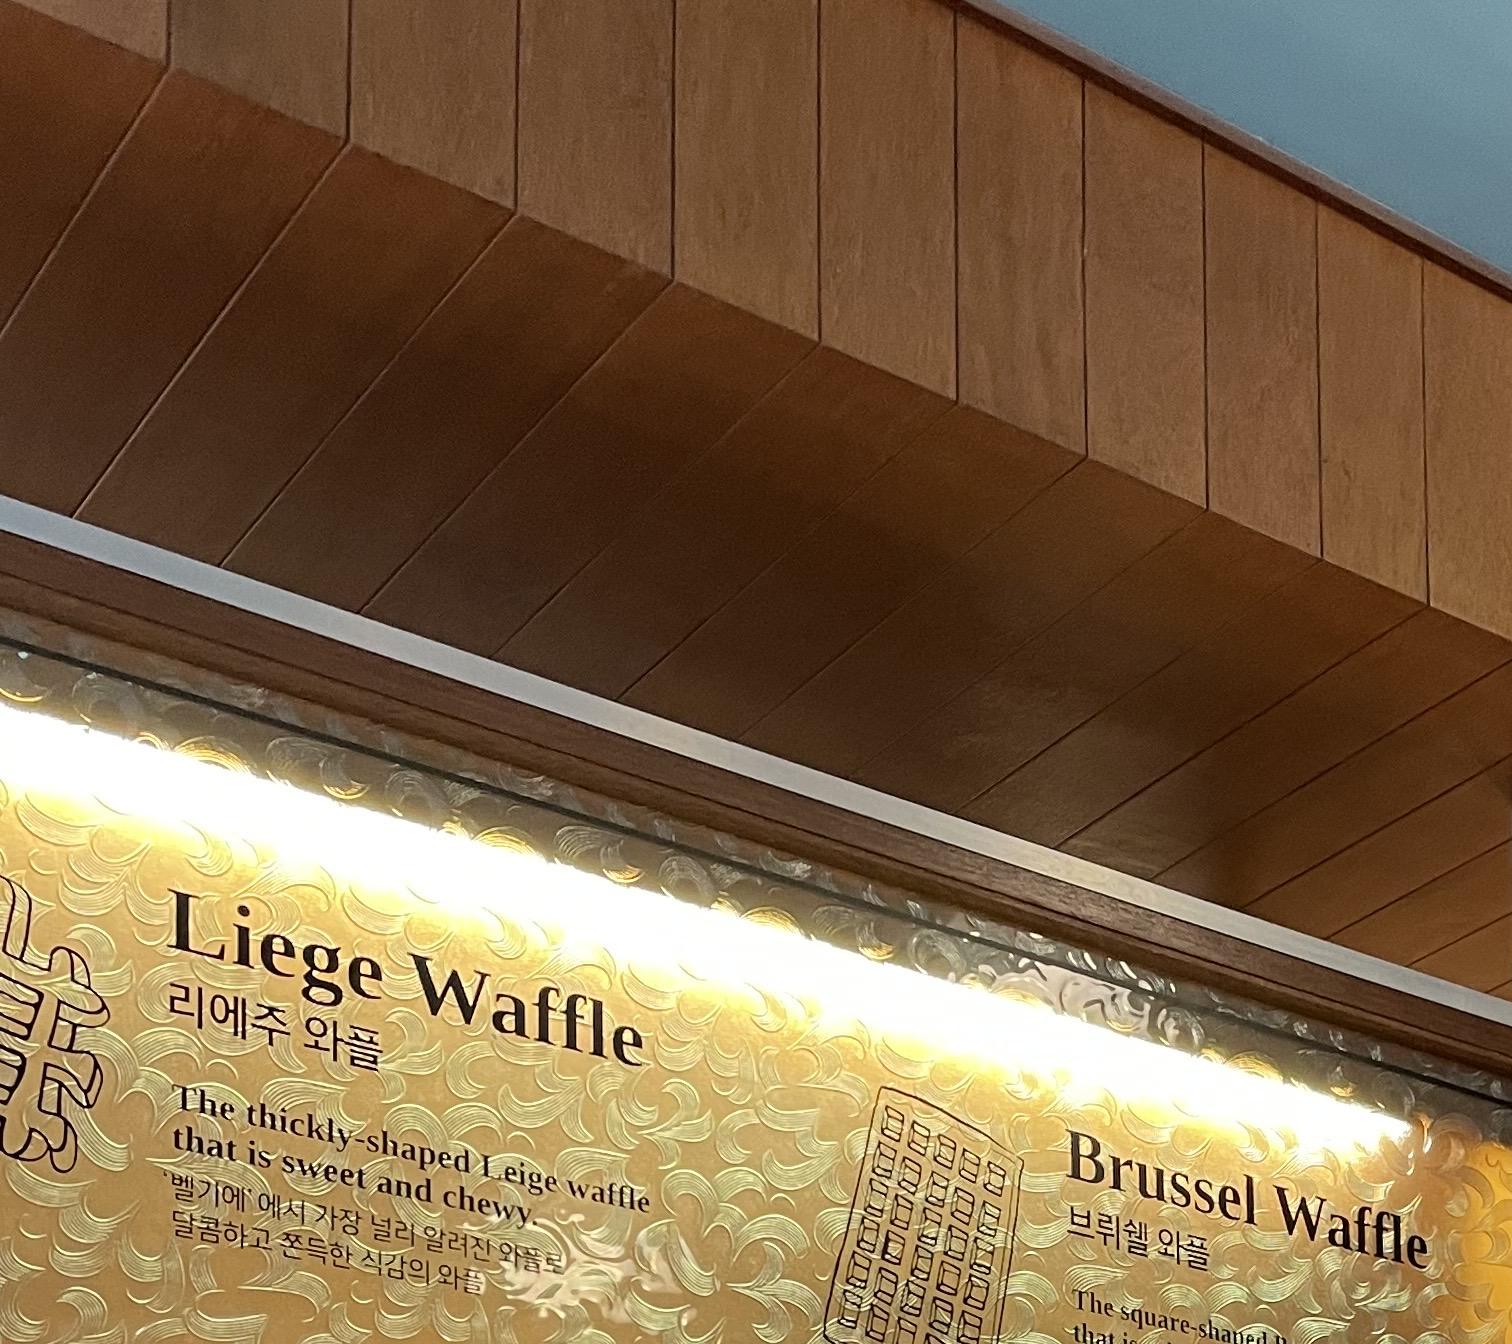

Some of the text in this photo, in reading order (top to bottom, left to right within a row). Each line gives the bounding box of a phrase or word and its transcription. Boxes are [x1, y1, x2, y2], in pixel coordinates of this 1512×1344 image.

[167, 888, 648, 1067] Liege Waffle
[166, 982, 383, 1072] 리에주 와플
[172, 1084, 650, 1213] The thickly-shaped Leige waffle
[173, 1126, 538, 1229] that is sweet and chewy.
[258, 1192, 306, 1226] 에서
[315, 1204, 362, 1236] 가장
[371, 1215, 416, 1248] 널리
[423, 1225, 491, 1263] 알려진
[499, 1241, 565, 1276] 와플로
[1066, 1128, 1430, 1269] Brussel Waffle
[1067, 1206, 1210, 1273] 브뤼쉘 와플
[172, 1210, 486, 1297] 달콤하고 쫀득한 식감의 와플
[1072, 1288, 1114, 1318] The
